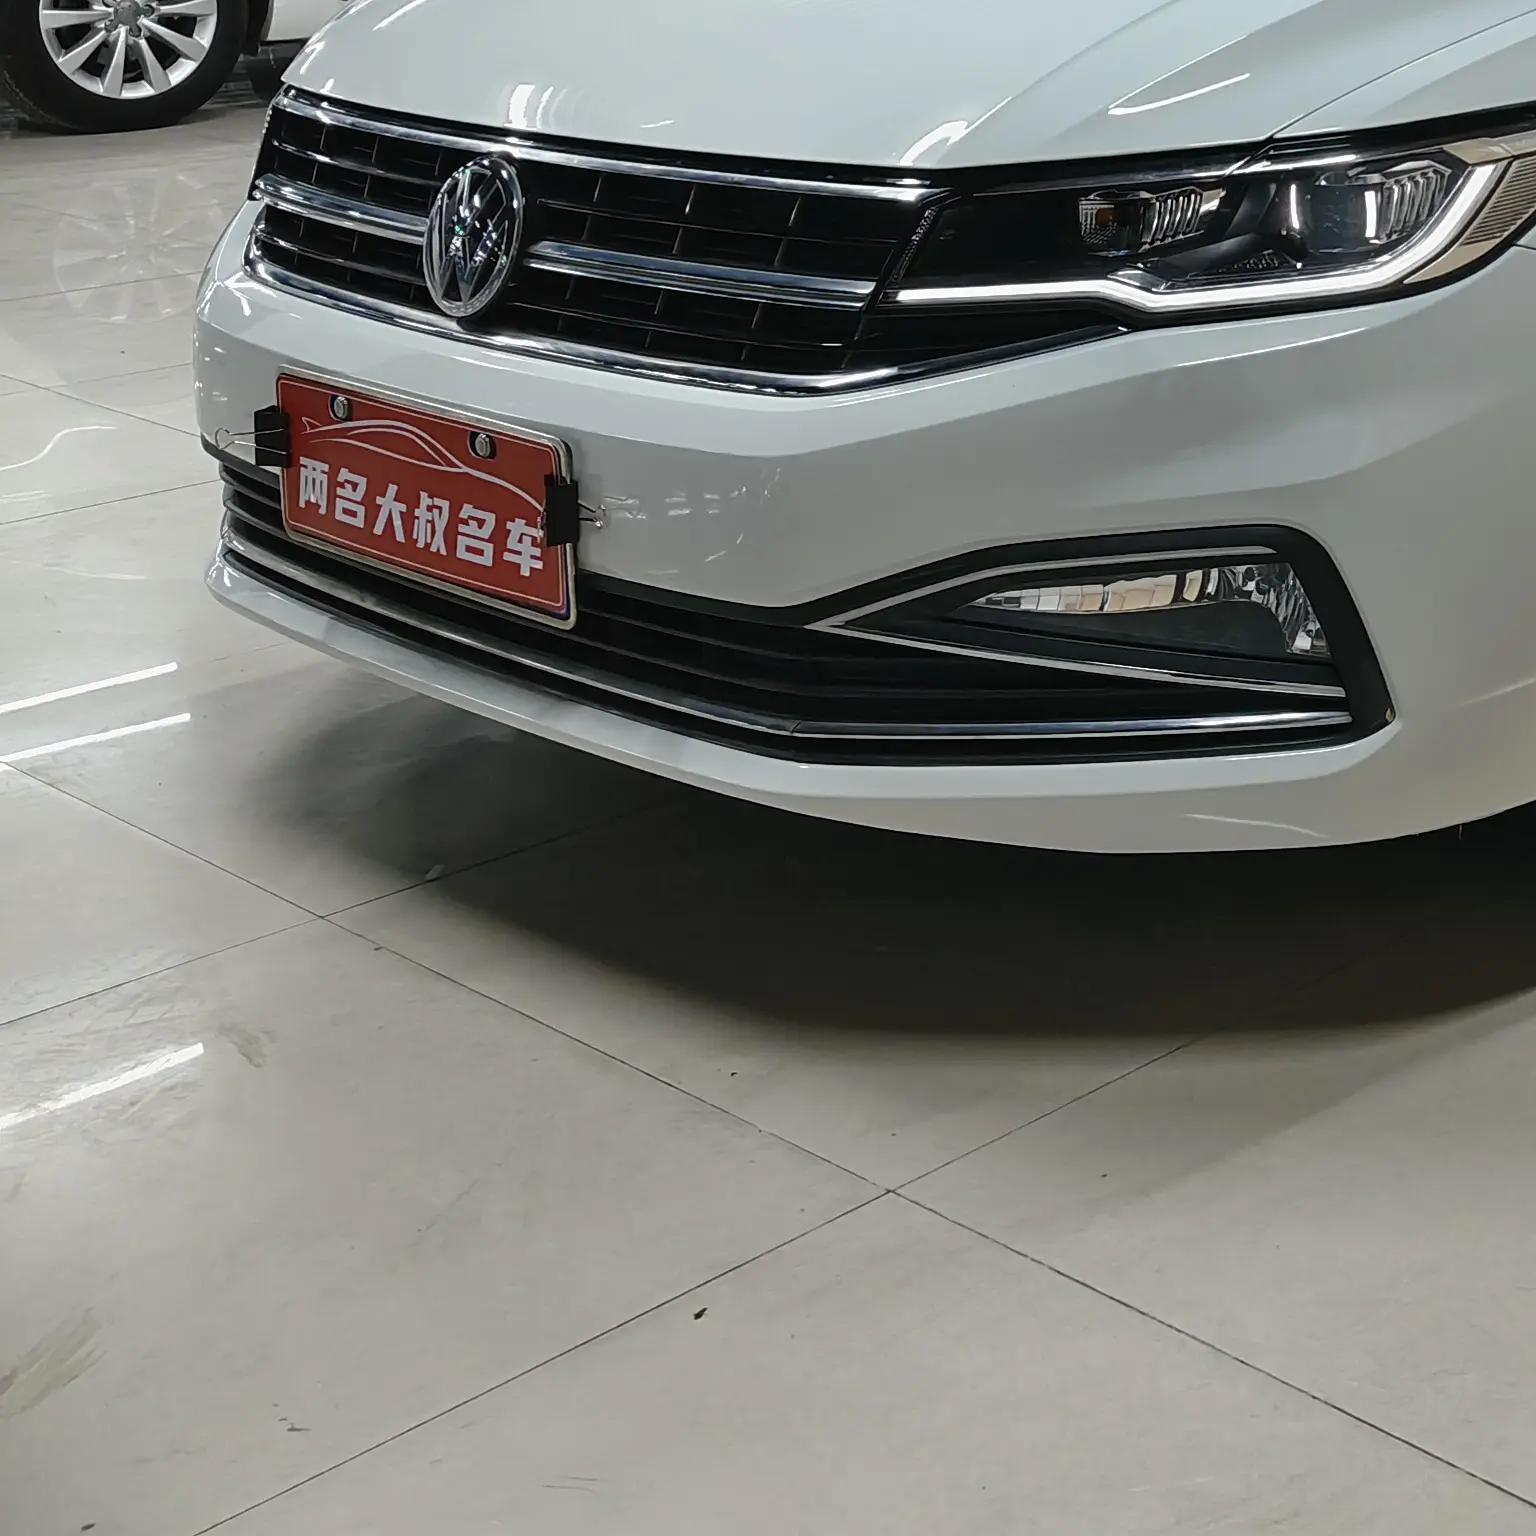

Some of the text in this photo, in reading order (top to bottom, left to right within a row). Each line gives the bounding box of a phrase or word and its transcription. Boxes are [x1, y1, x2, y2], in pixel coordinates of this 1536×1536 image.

[298, 456, 545, 577] 两名大叔名车
